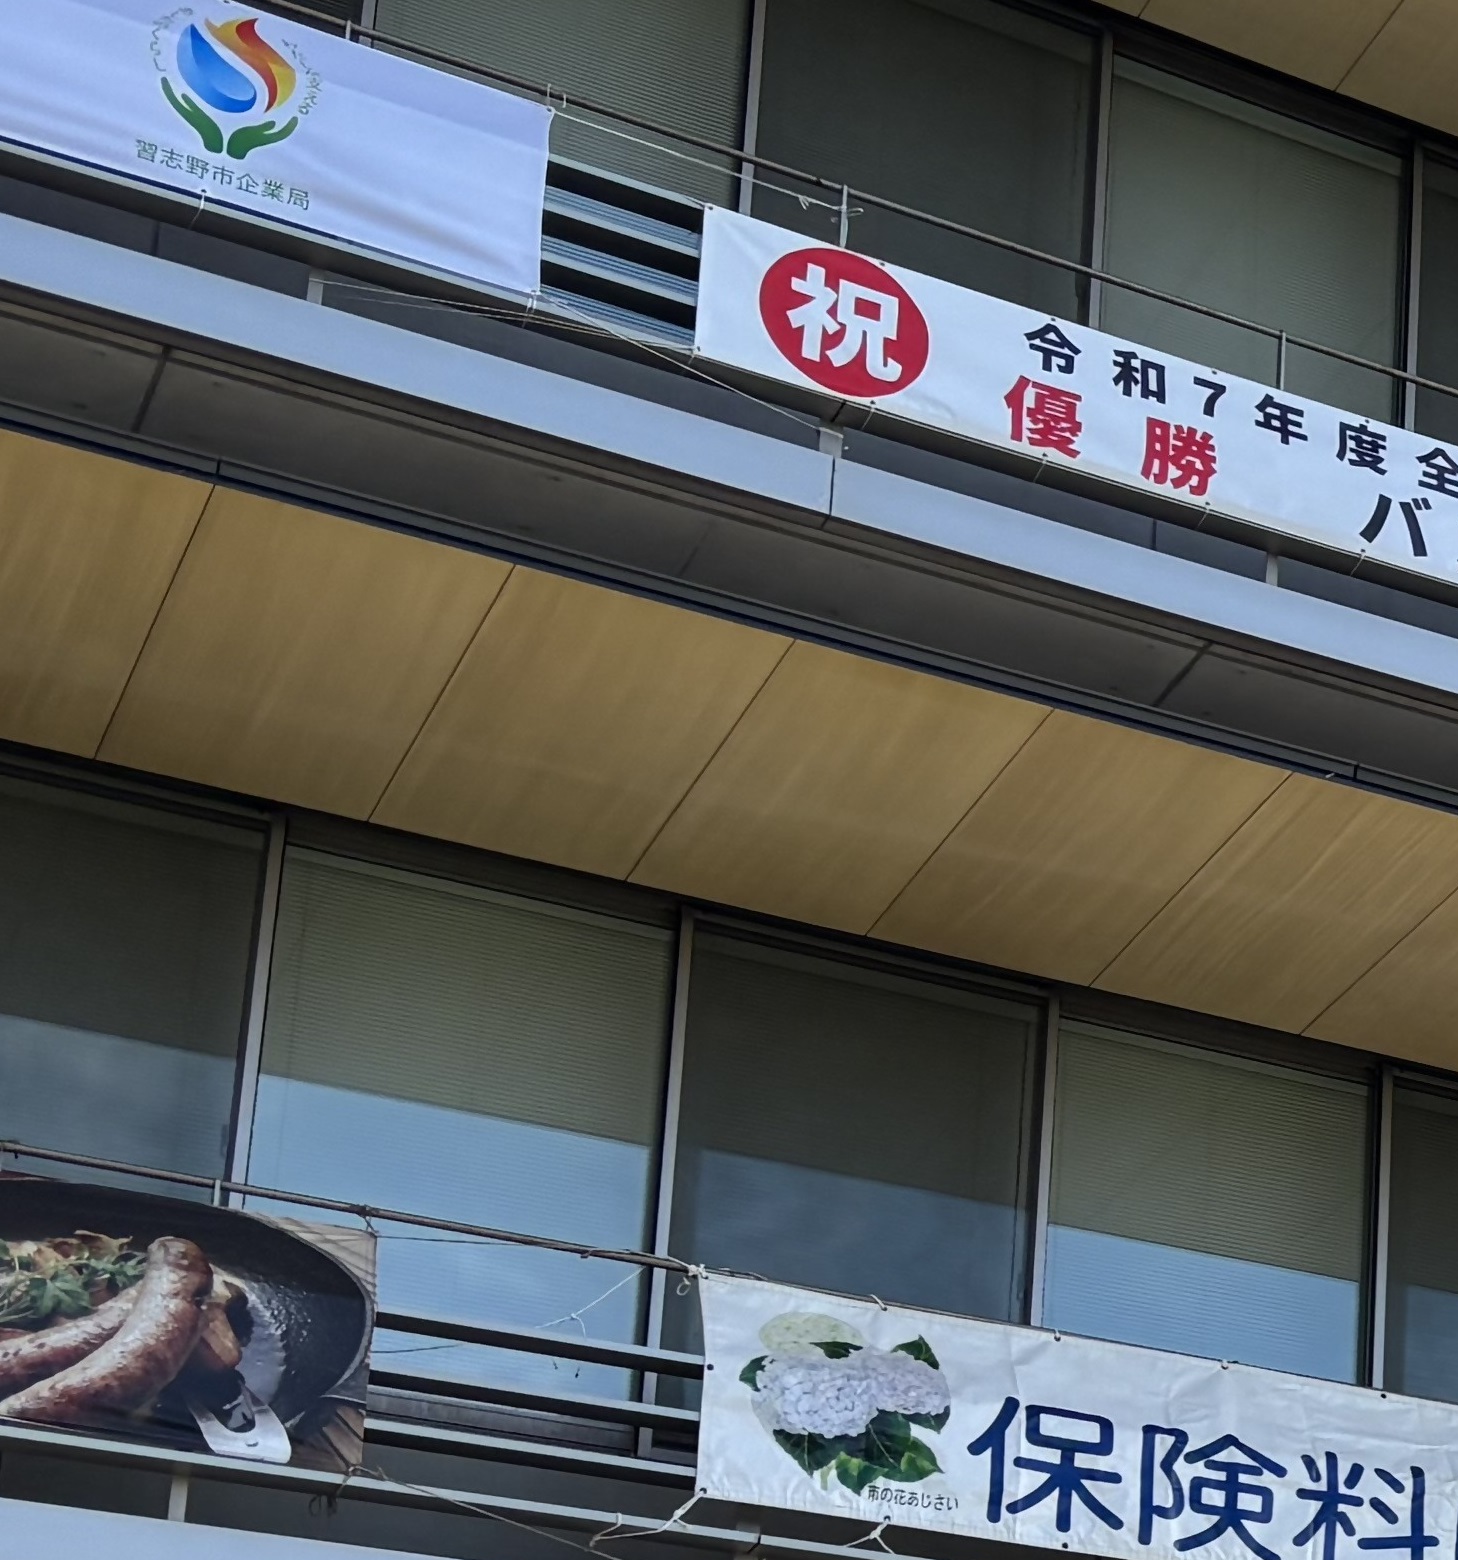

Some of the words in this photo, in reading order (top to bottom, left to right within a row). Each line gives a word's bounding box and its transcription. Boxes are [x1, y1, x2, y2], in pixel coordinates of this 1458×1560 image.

[135, 139, 310, 211] 習志野市企業局
[785, 262, 903, 383] 祝
[1002, 374, 1218, 497] 優勝
[866, 1484, 959, 1512] 市の花あじさい
